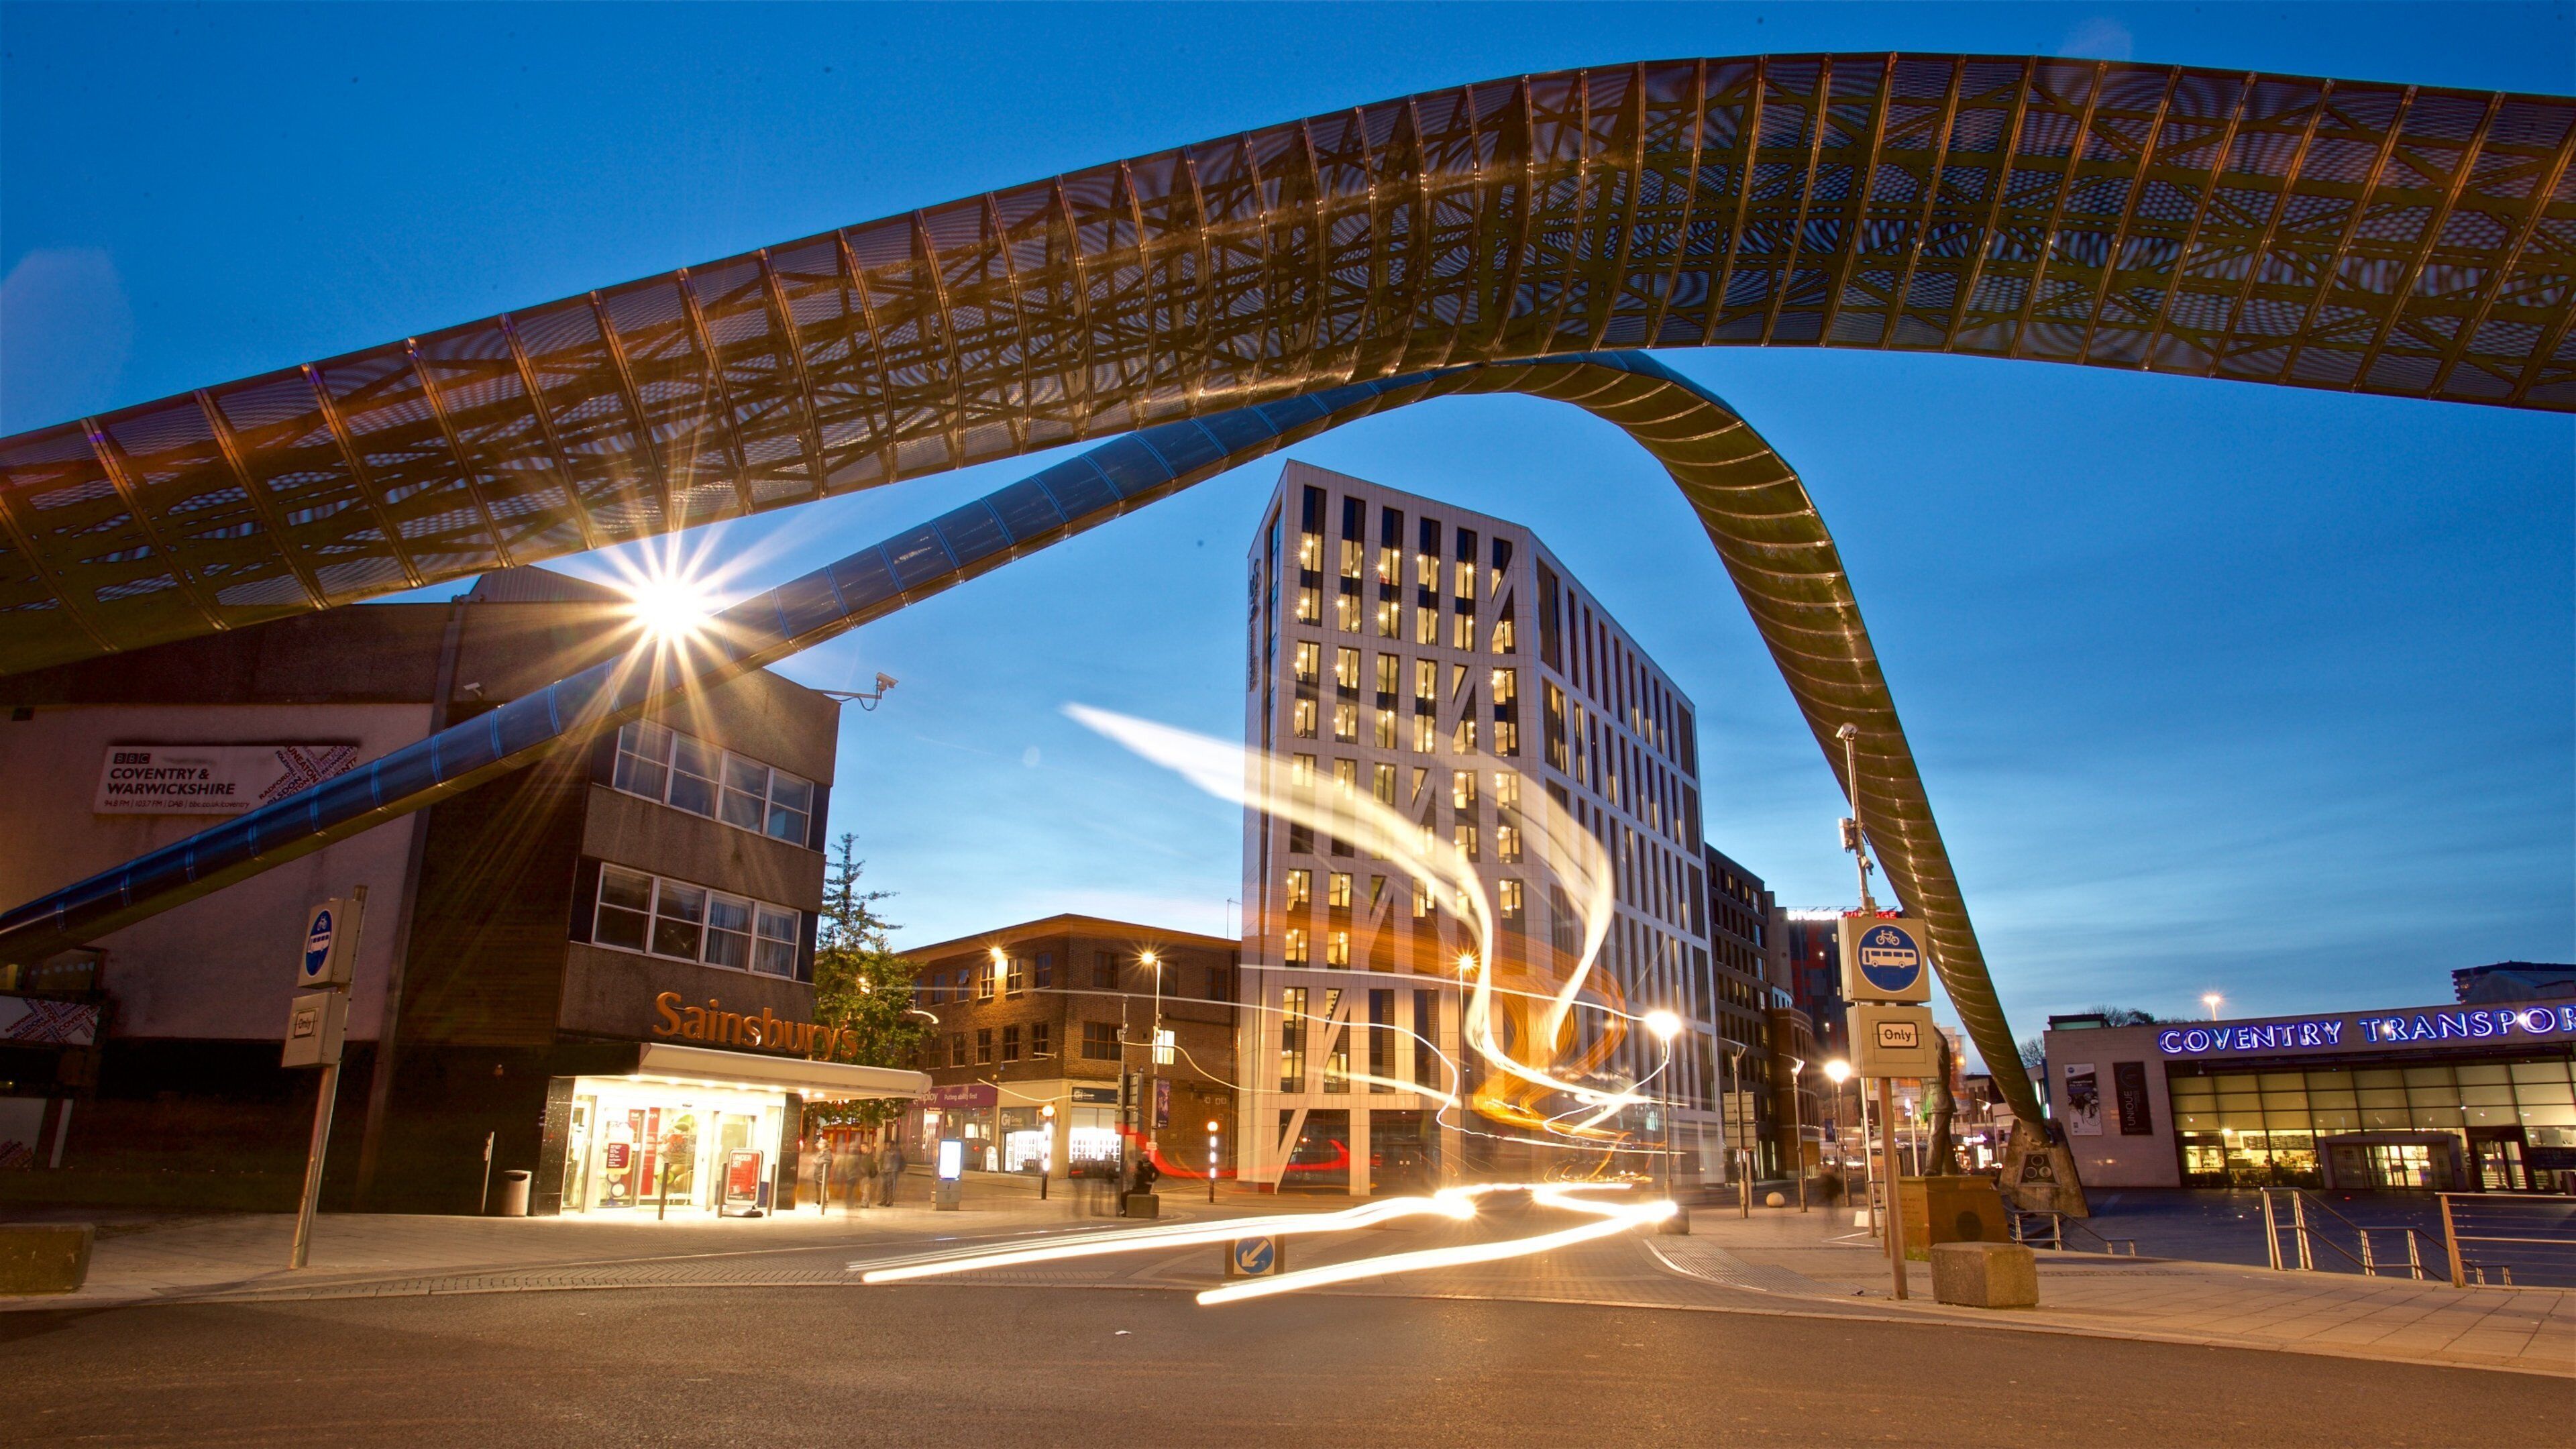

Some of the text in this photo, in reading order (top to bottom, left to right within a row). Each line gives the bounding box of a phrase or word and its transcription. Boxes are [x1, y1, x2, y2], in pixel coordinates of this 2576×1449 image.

[113, 753, 151, 764] BBC
[110, 768, 210, 780] COVENTRY &
[107, 783, 235, 795] WARWICKSHIRE
[298, 1018, 311, 1030] Only
[652, 991, 859, 1062] Sainsbury's
[2158, 1005, 2576, 1055] COVENTRY TRANSPOR
[1884, 1029, 1911, 1042] Only
[957, 1093, 969, 1102] ability
[2124, 1090, 2136, 1126] UNIQUE
